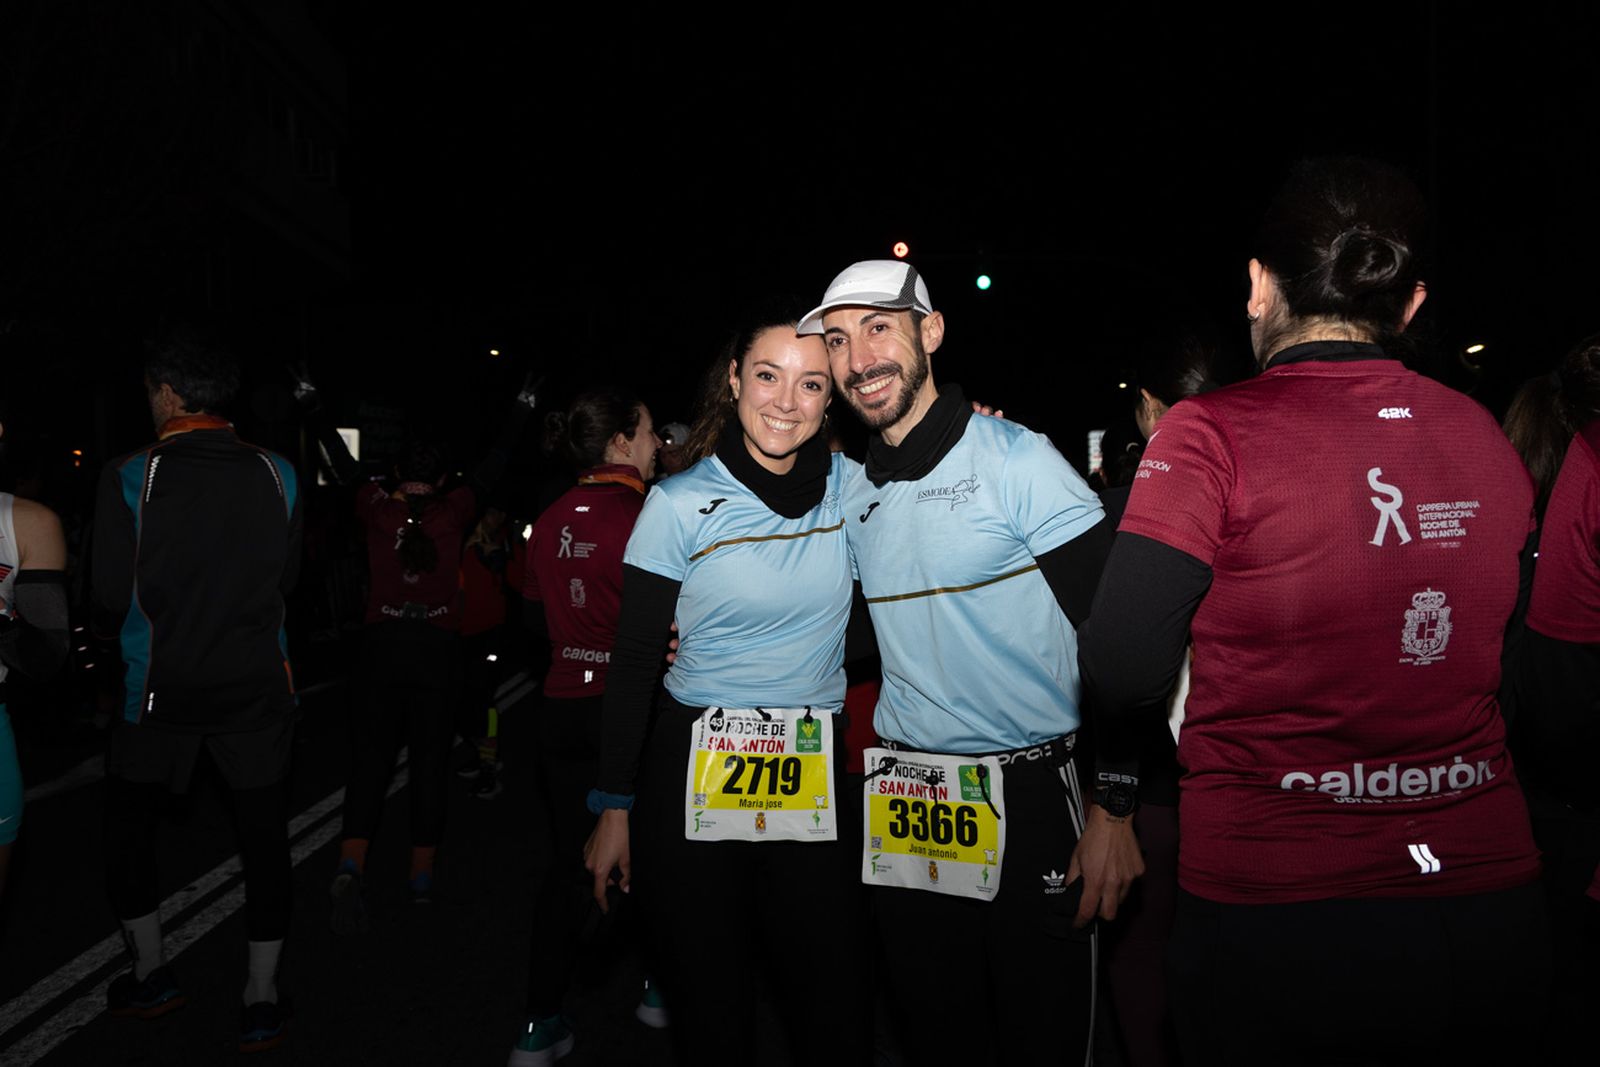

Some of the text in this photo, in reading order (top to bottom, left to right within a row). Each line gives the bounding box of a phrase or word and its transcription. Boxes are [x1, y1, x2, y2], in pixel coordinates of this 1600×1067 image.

[1376, 407, 1413, 419] 42K
[1416, 500, 1480, 513] CARRERA URBANA
[1418, 510, 1476, 521] INTERNACIONAL
[1420, 519, 1460, 530] NOCHE DE
[1421, 526, 1466, 540] SAN ANTÓN
[771, 724, 785, 736] DE
[739, 736, 785, 753] ANTÓN
[722, 755, 802, 796] 2719
[894, 765, 928, 782] NOCHE
[879, 780, 906, 796] SAN
[738, 798, 763, 808] Maria
[888, 797, 978, 848] 3366
[909, 844, 958, 860] Juan antonio
